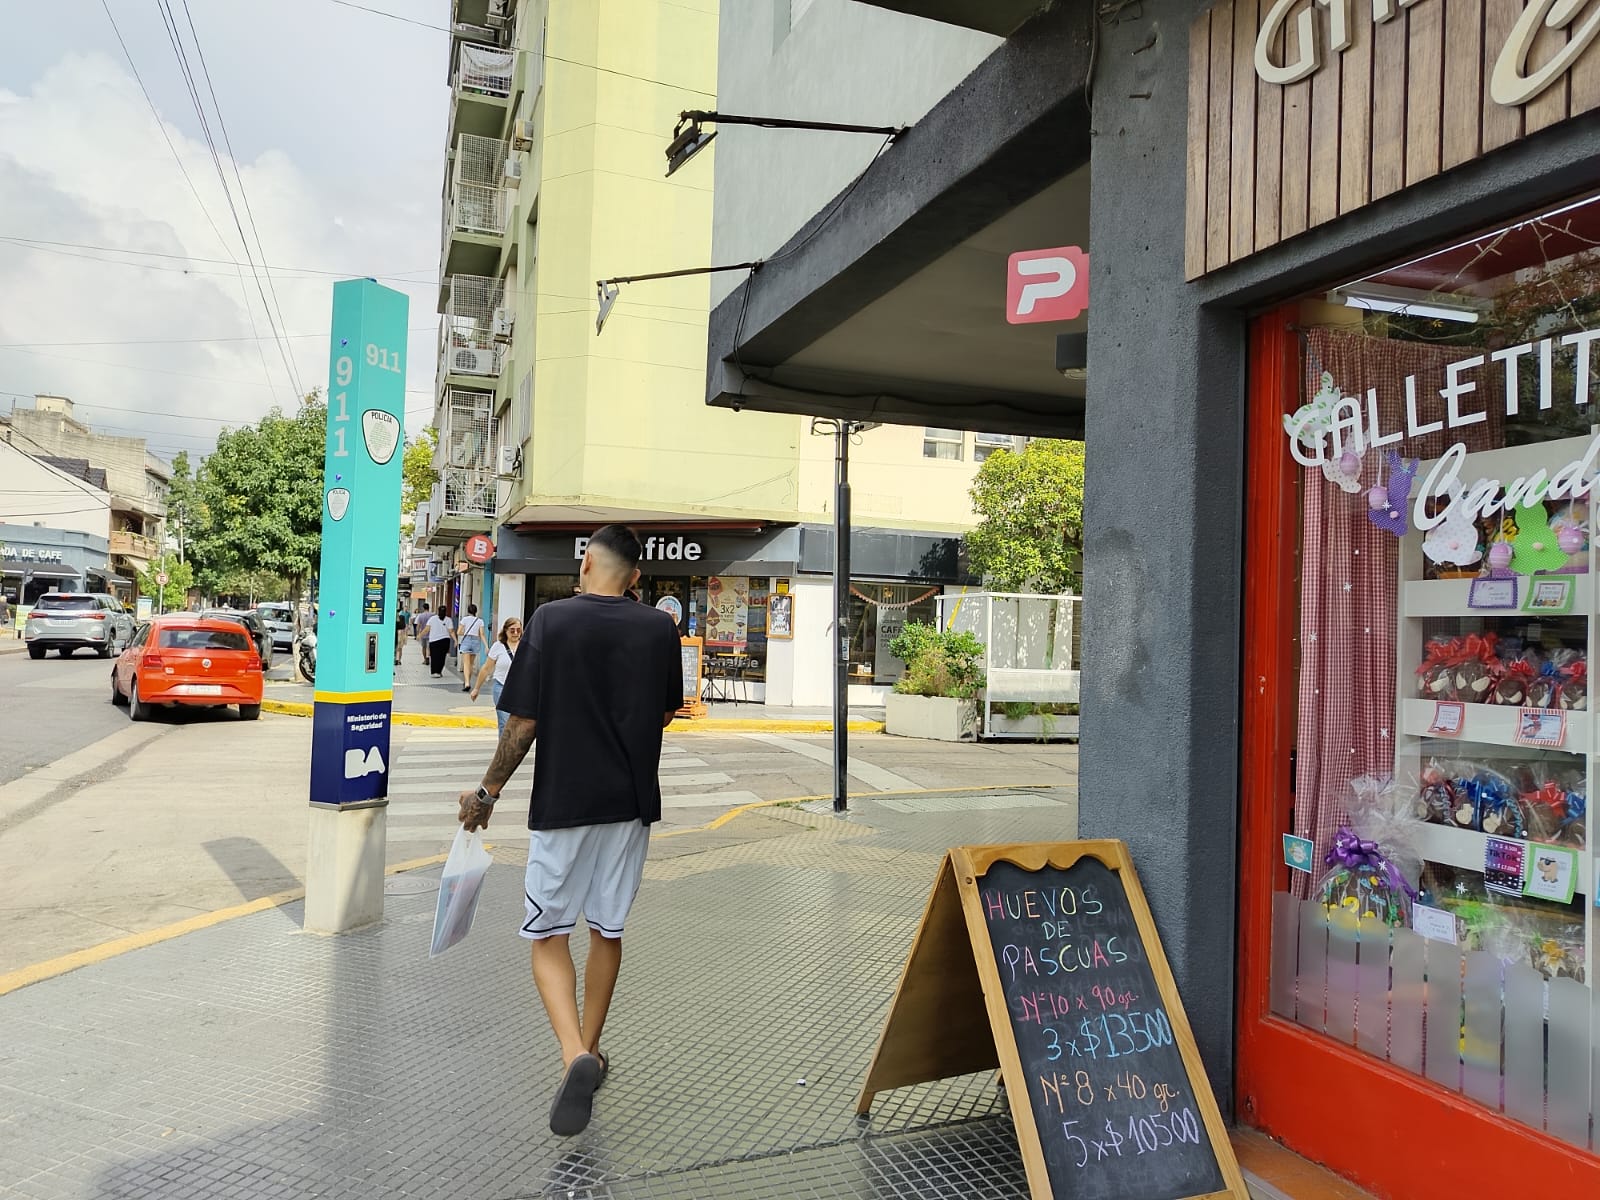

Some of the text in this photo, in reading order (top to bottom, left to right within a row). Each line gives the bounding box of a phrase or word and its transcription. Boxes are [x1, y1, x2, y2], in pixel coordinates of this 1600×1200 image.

[366, 344, 401, 373] 911
[371, 411, 393, 424] POLICIA
[22, 548, 35, 558] DE
[473, 538, 487, 555] B
[574, 536, 702, 561] Bfide
[720, 604, 735, 614] 3x2
[347, 713, 378, 722] Ministerio
[351, 721, 383, 732] Seguridad
[345, 746, 386, 779] BA
[985, 887, 1103, 921] HUEVOS
[1041, 920, 1071, 940] DE
[1002, 936, 1128, 982] PASCUAS
